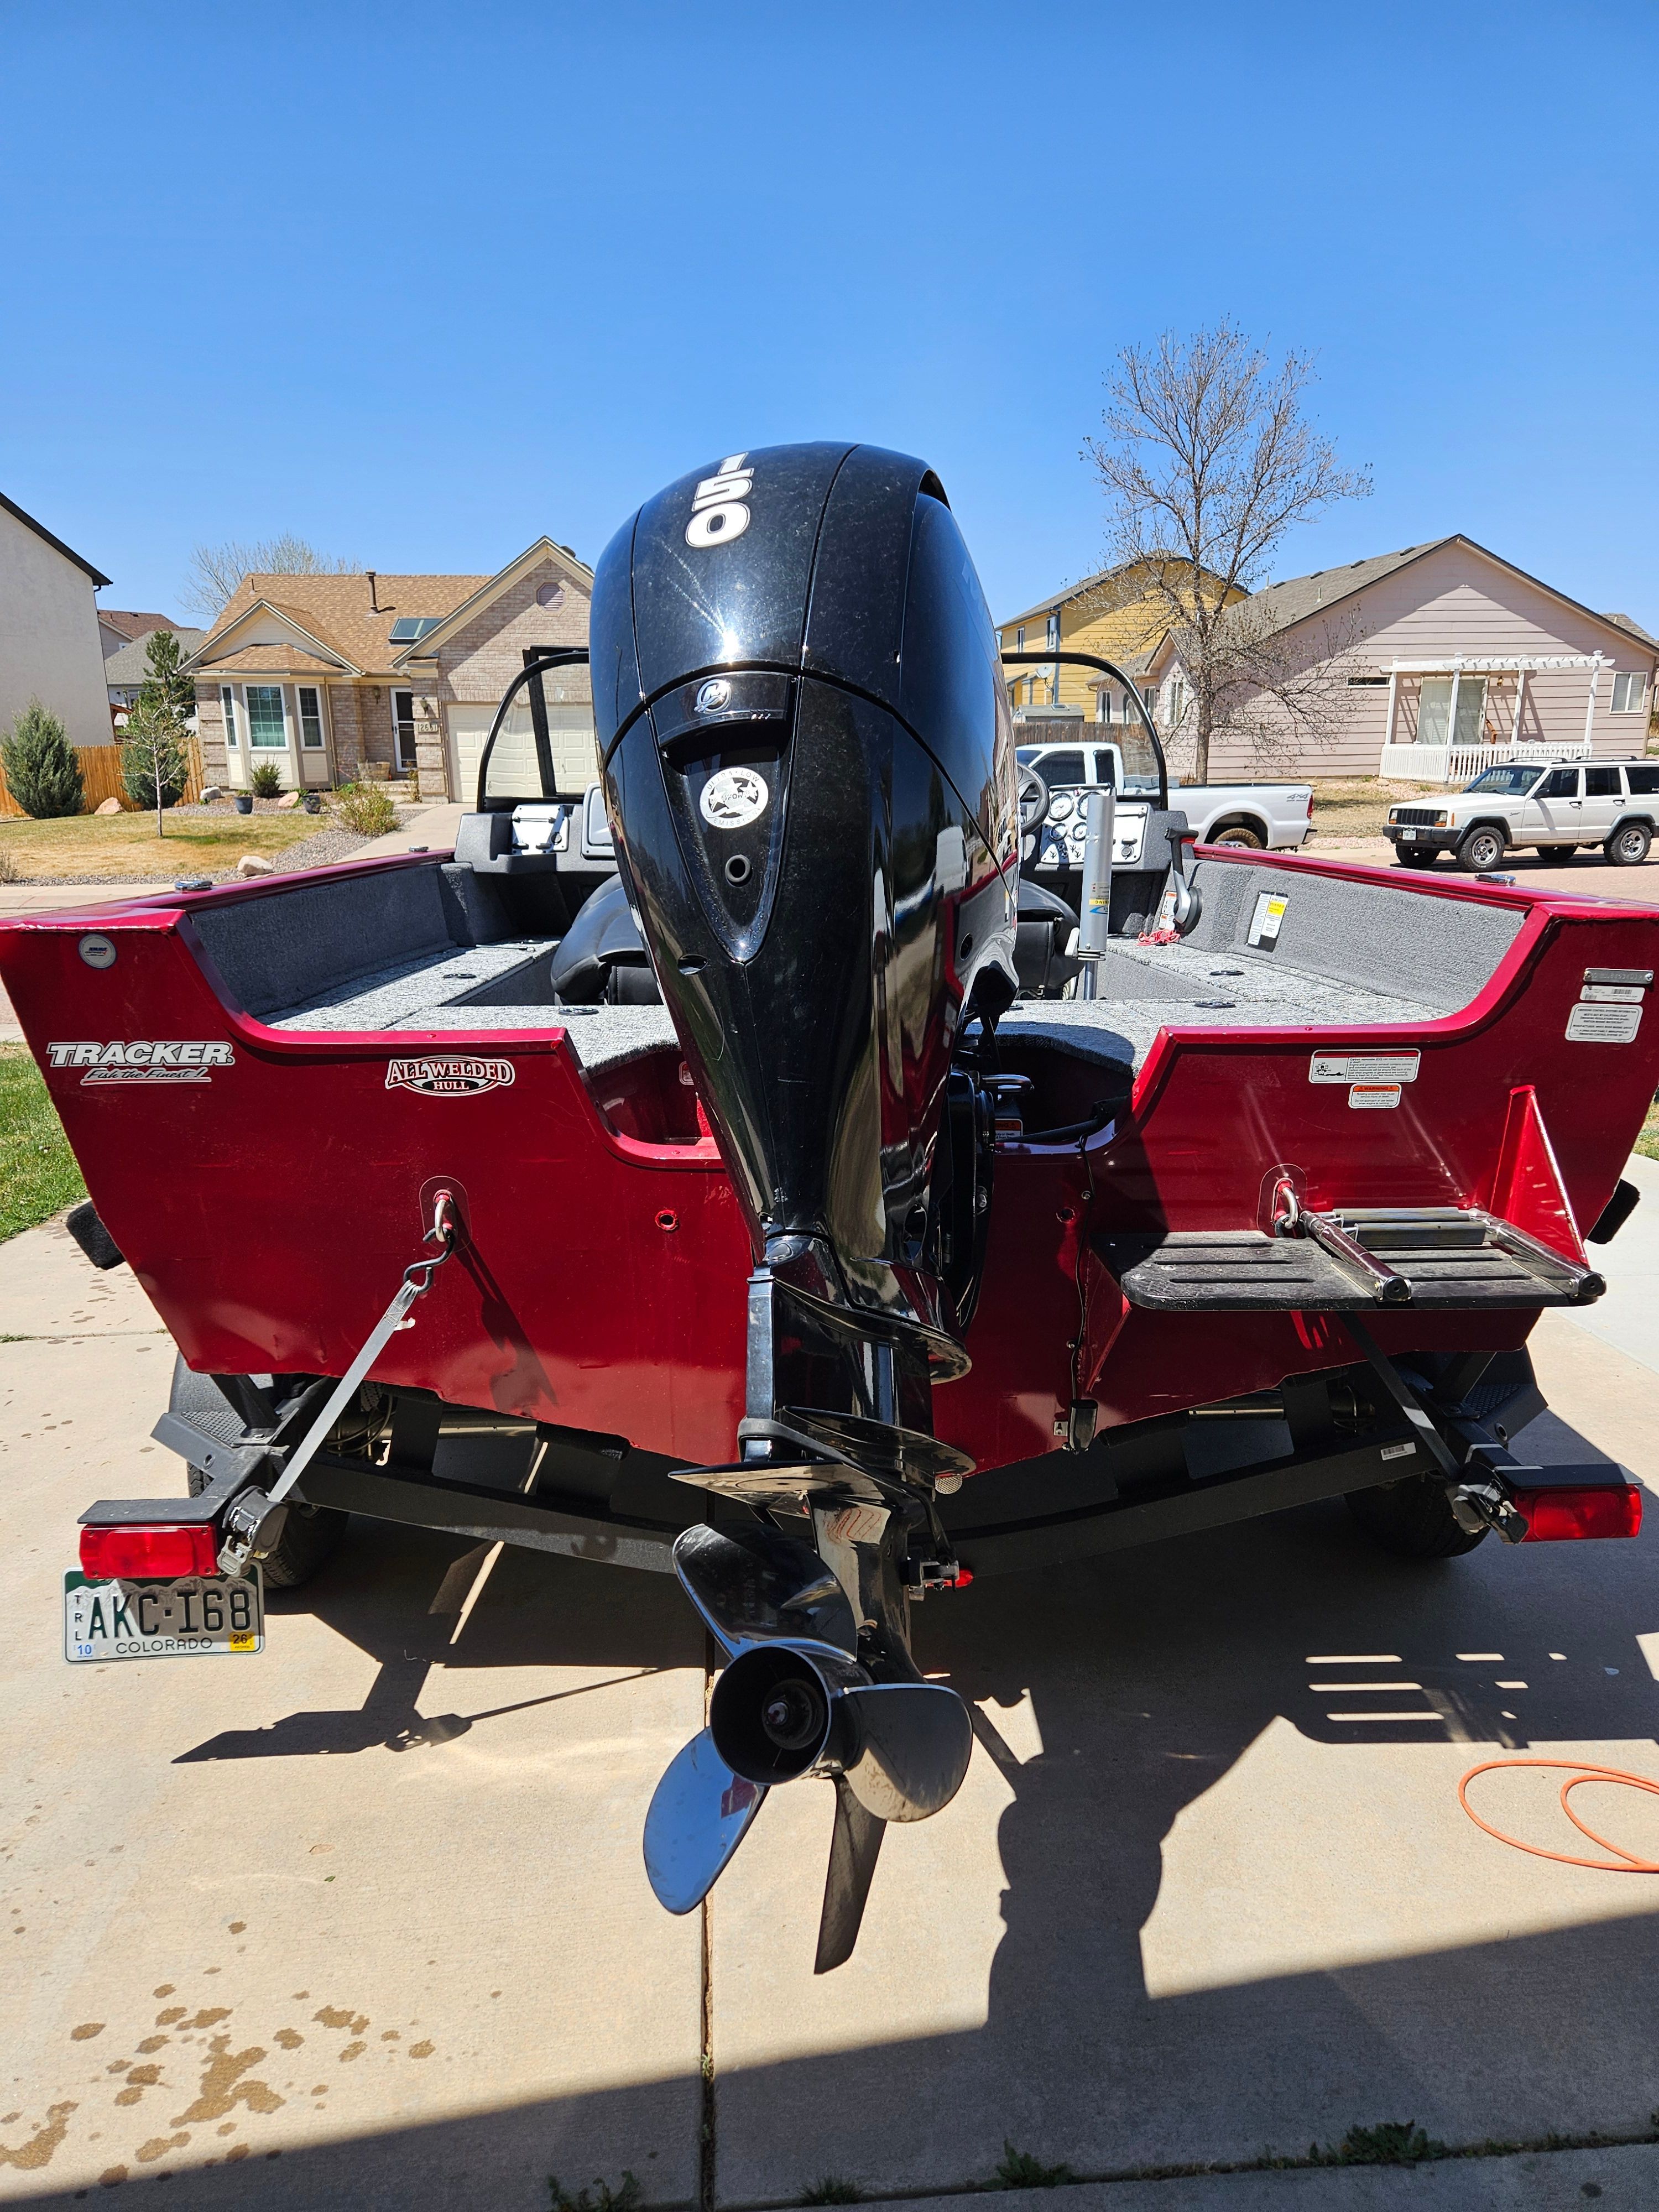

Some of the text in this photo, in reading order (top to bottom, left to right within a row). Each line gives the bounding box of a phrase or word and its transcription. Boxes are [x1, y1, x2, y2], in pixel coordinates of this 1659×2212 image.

[685, 452, 755, 548] 150
[50, 1043, 230, 1065] TRACKER
[87, 1069, 118, 1079] Fish
[121, 1068, 142, 1078] the
[429, 1062, 511, 1083] WELDED
[433, 1081, 469, 1090] HULL
[116, 1637, 213, 1653] COLORADO
[232, 1634, 248, 1645] 26
[77, 1645, 92, 1655] 10
